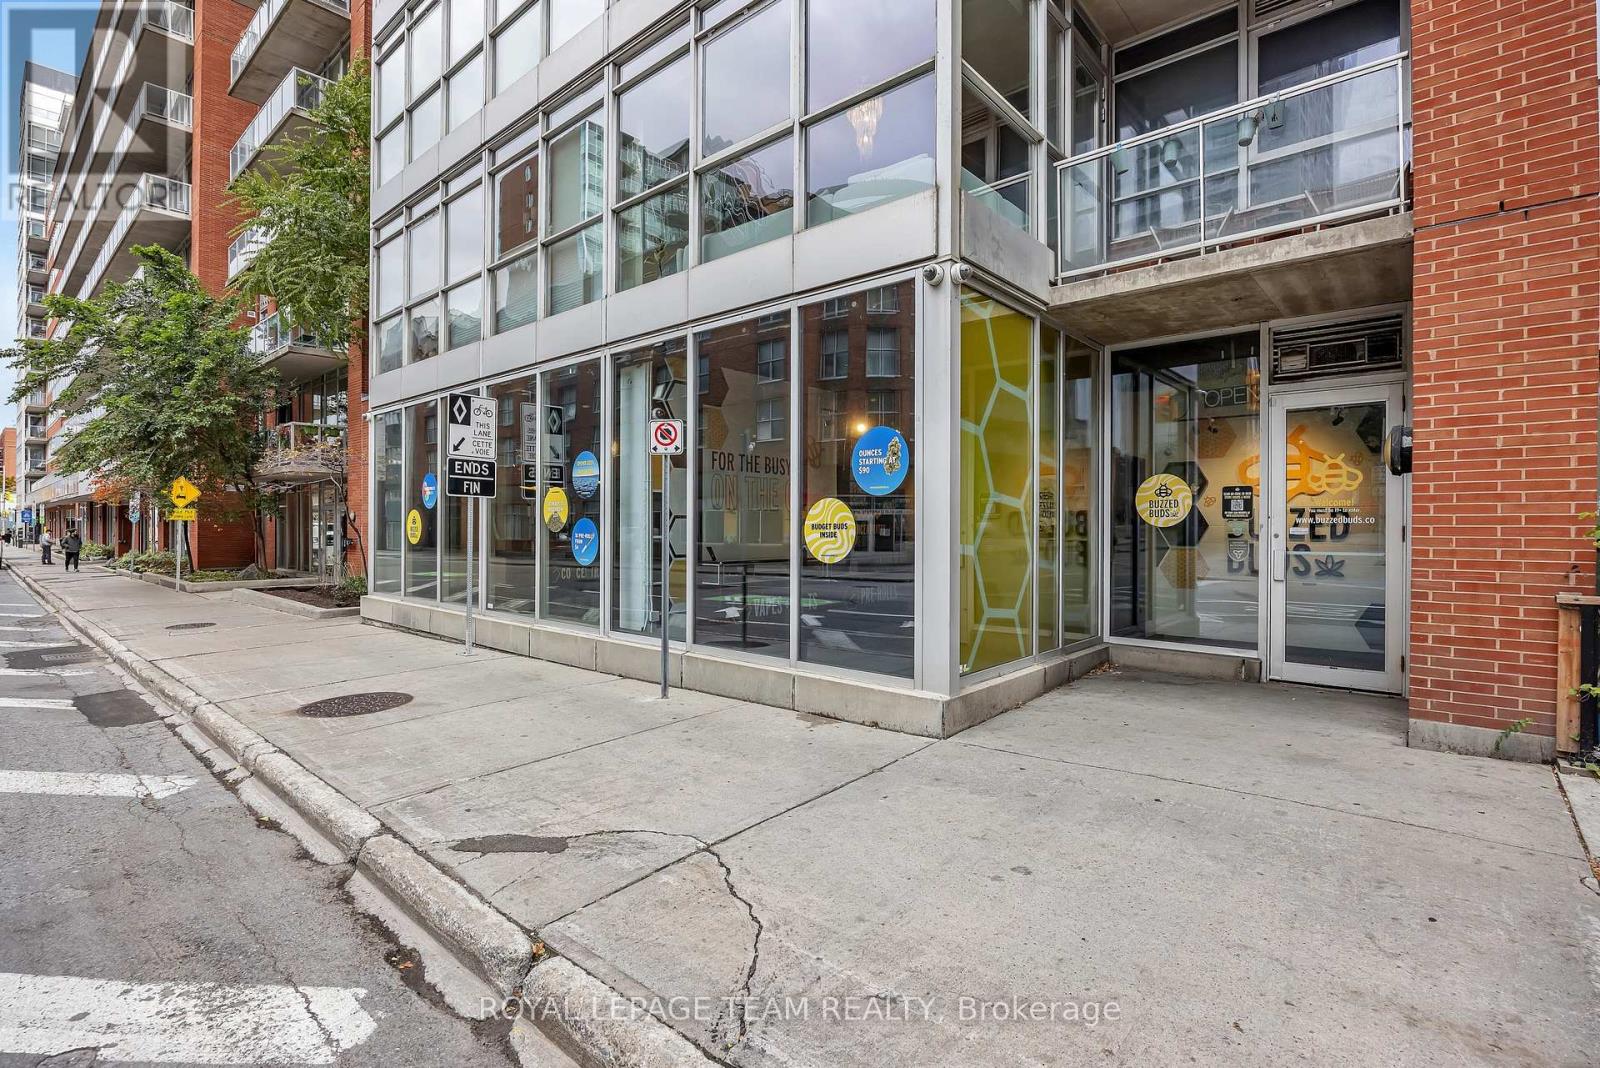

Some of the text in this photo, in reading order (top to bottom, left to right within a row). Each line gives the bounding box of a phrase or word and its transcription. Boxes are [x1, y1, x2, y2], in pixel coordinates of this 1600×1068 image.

[1205, 386, 1260, 407] OPEN
[476, 421, 490, 430] THIS
[473, 429, 492, 438] LANE
[472, 440, 493, 448] CETTE
[475, 448, 490, 456] VOIE
[858, 448, 882, 457] OUNCES
[711, 450, 735, 471] FOR
[739, 453, 760, 474] THE
[858, 456, 897, 466] STARTING AT
[454, 461, 489, 475] ENDS
[463, 481, 480, 494] FIN
[711, 473, 738, 510] ON
[744, 475, 780, 511] THE
[1148, 499, 1179, 509] BUZZED
[1148, 508, 1170, 518] BUDS
[1296, 515, 1375, 524] www.buzzedbuds.co
[833, 522, 849, 530] BUDS
[819, 531, 838, 539] INSIDE
